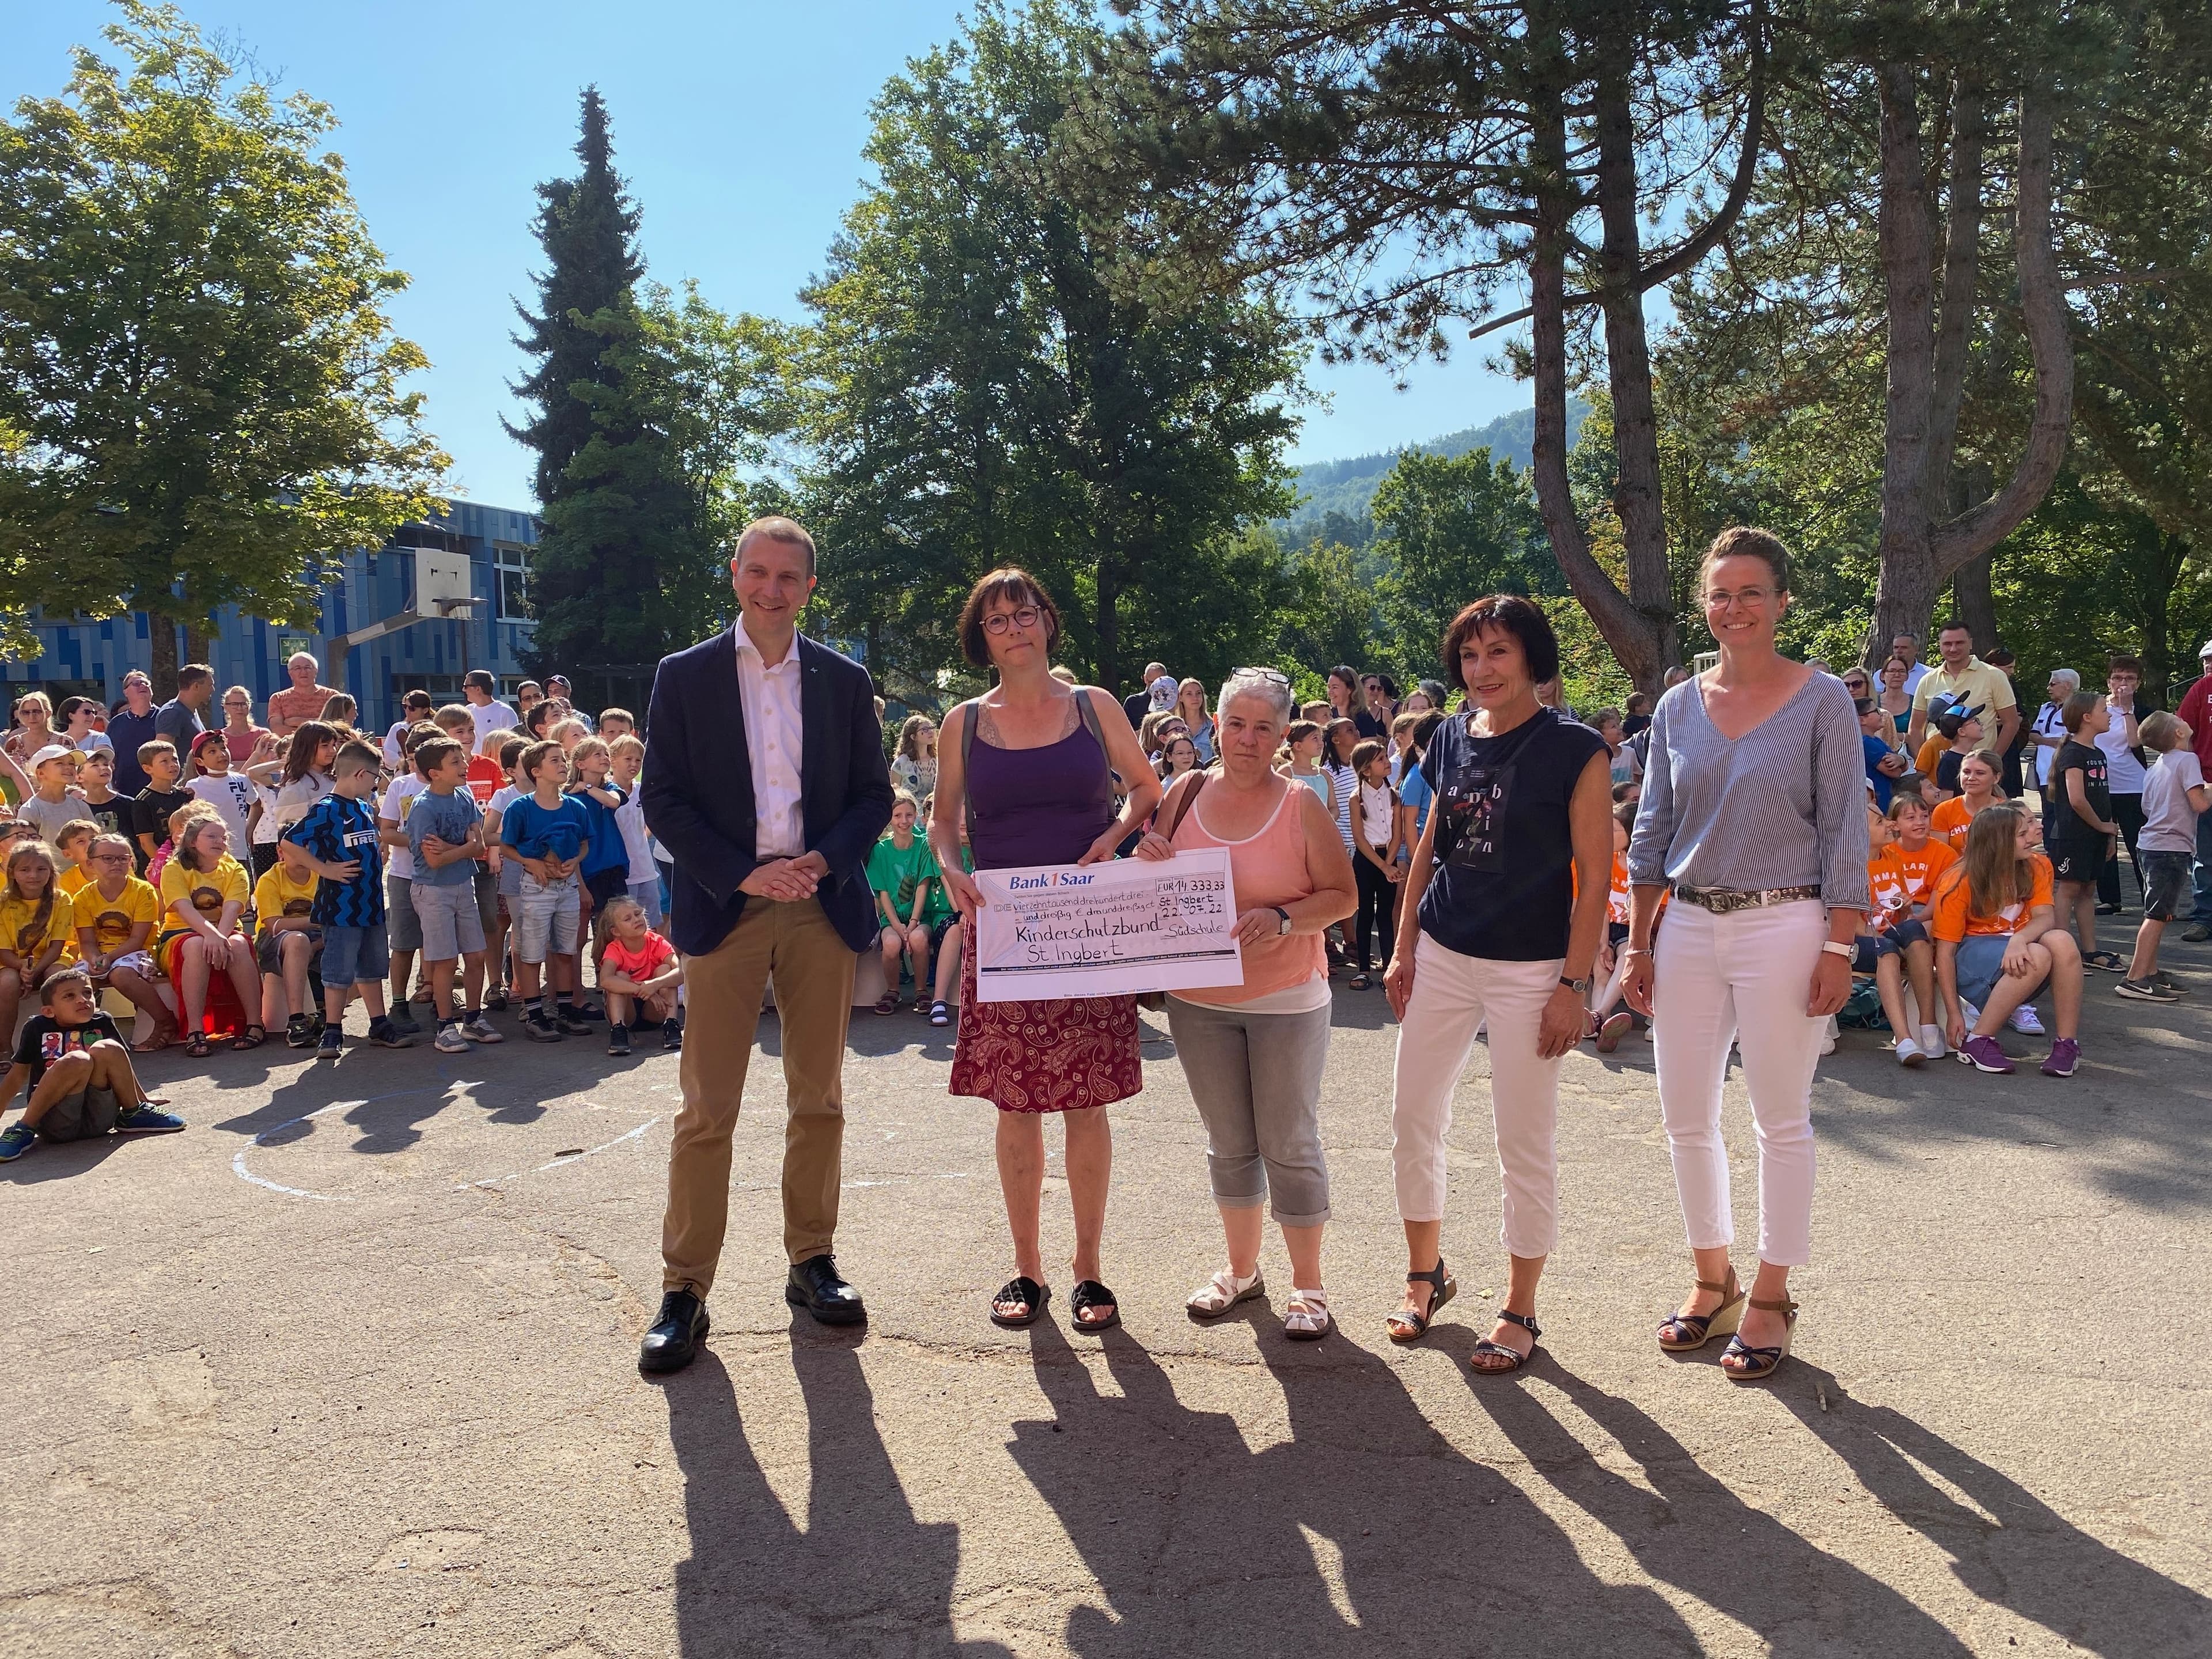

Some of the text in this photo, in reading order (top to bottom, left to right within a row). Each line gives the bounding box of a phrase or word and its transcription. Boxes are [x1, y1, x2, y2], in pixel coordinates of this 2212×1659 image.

[343, 830, 376, 847] PIRE
[1010, 873, 1048, 889] Bank
[1060, 873, 1094, 886] Saar
[1871, 872, 1897, 885] MMA
[1158, 882, 1173, 892] EUR
[1175, 893, 1214, 908] Ingbert
[1016, 912, 1162, 942] Kinderschutzbund
[1164, 920, 1224, 937] Südschule
[1056, 940, 1123, 964] Ingbert
